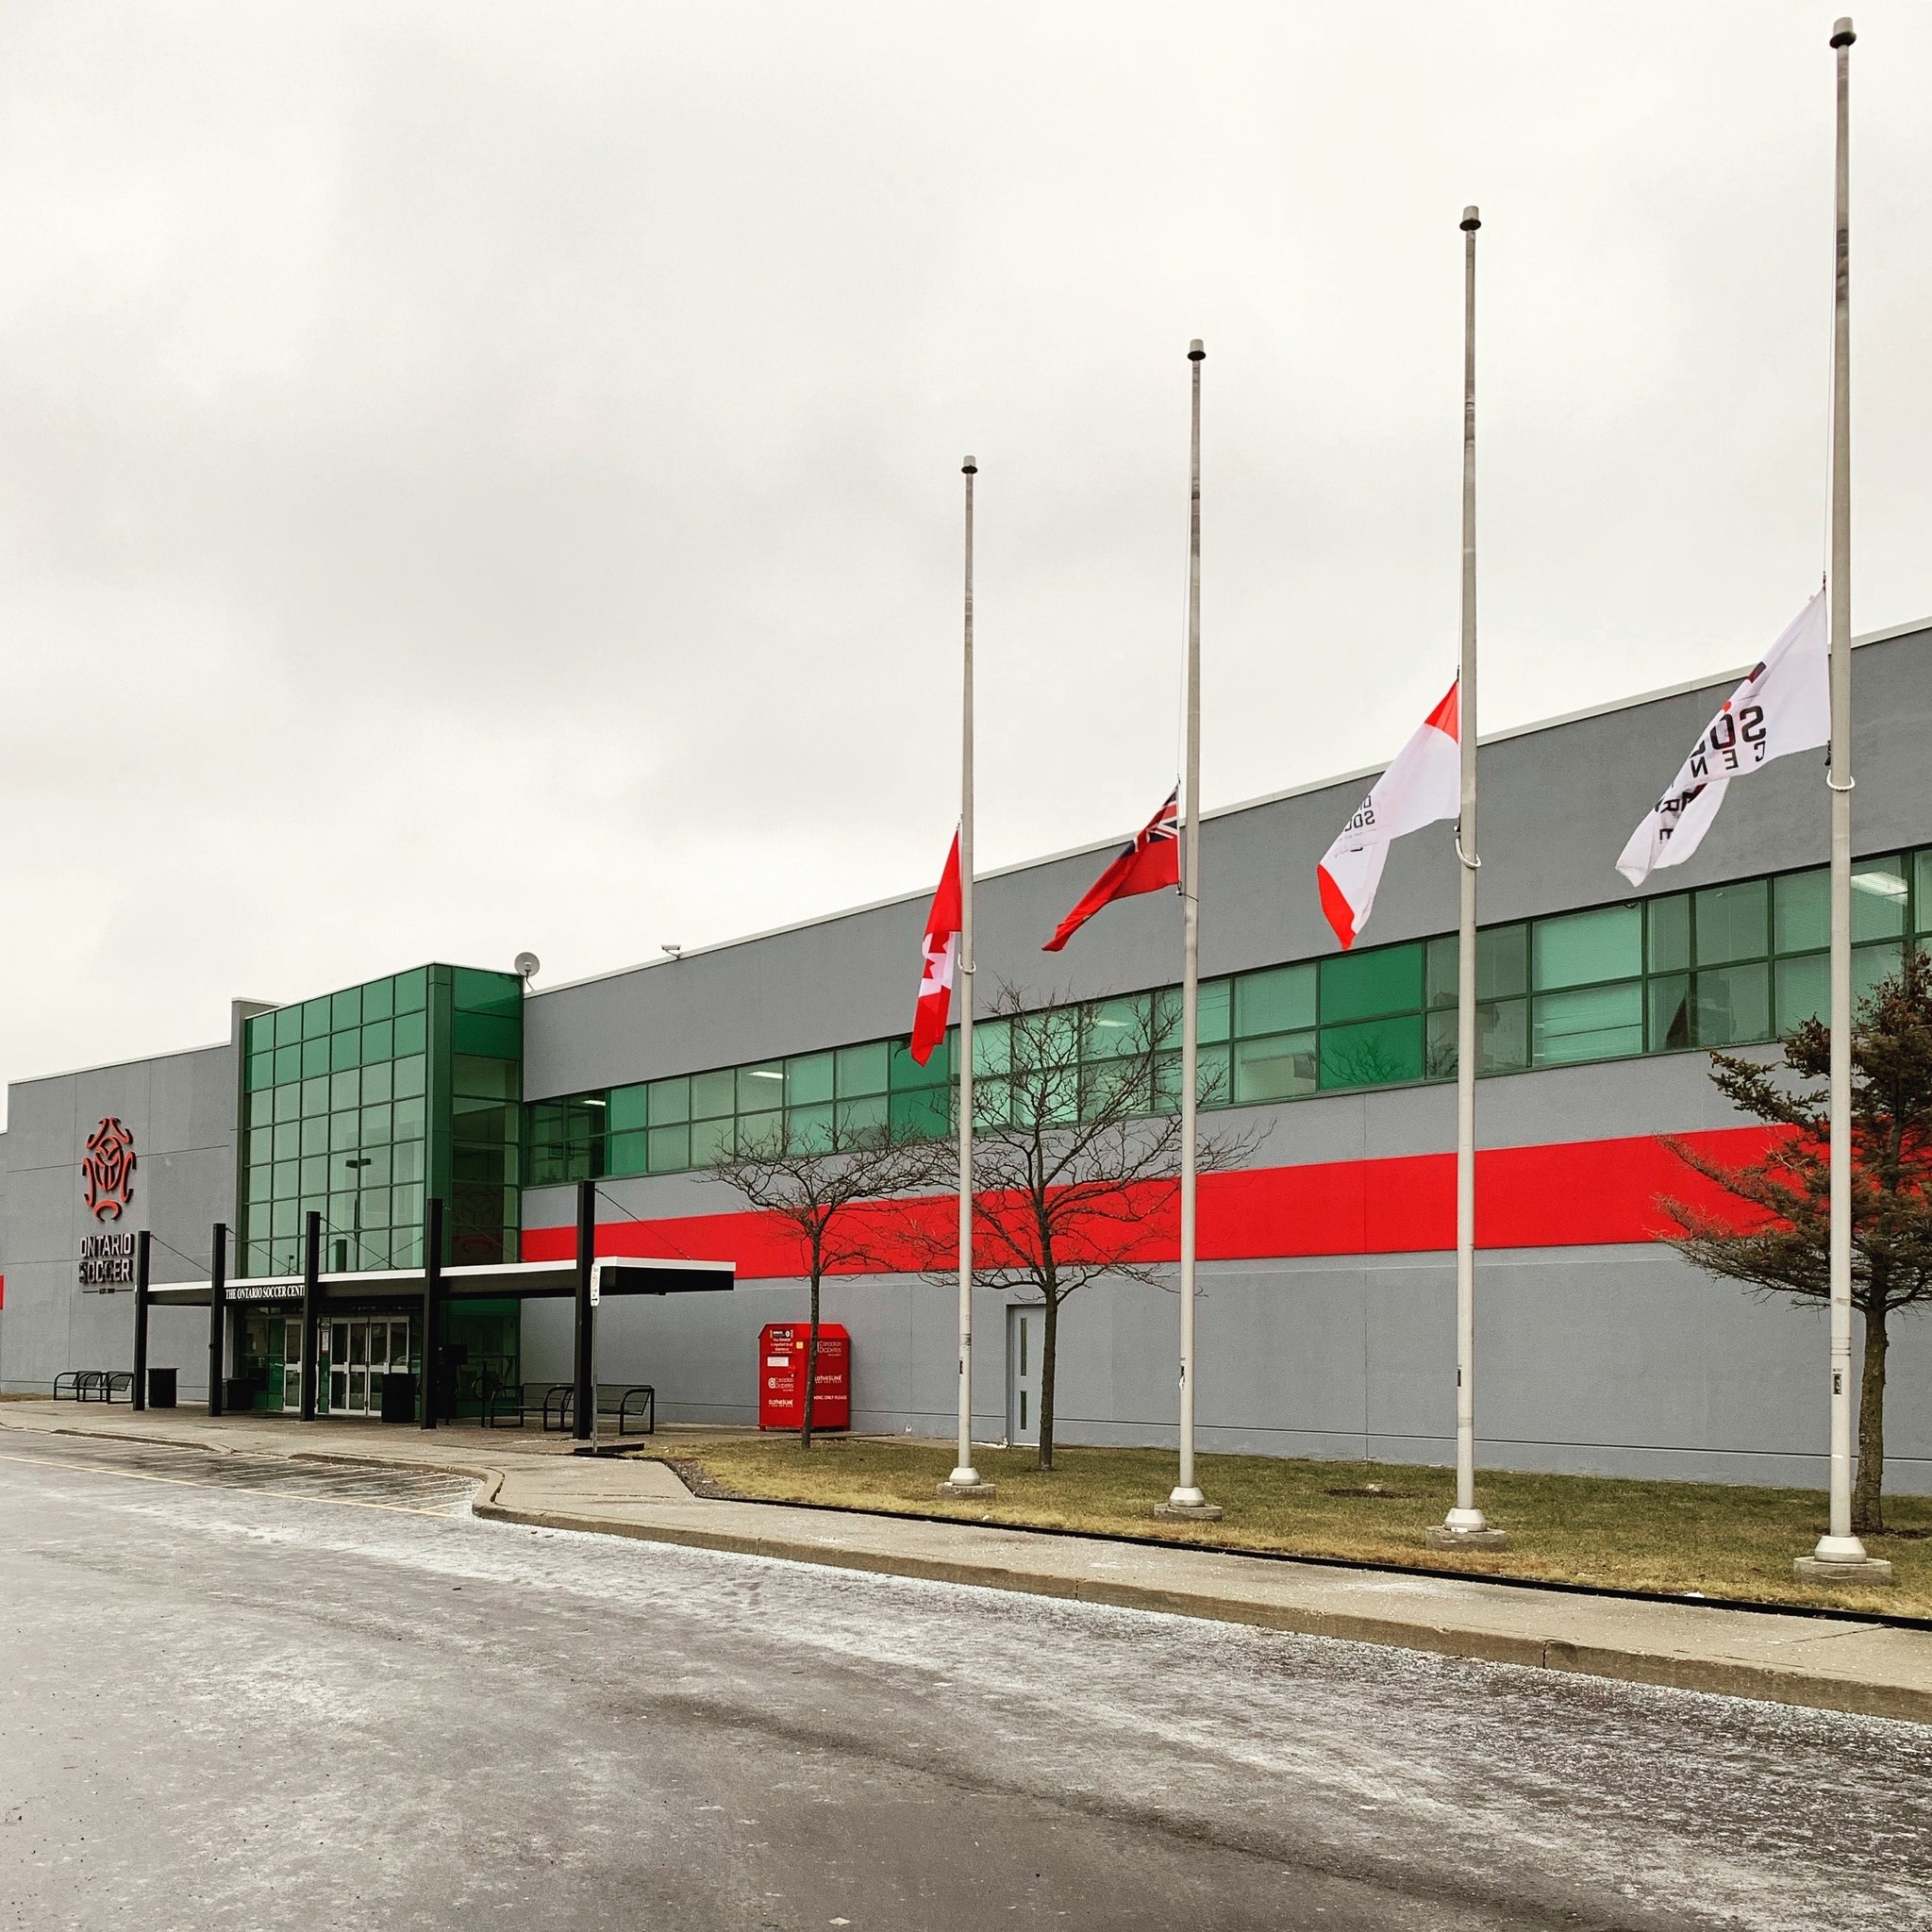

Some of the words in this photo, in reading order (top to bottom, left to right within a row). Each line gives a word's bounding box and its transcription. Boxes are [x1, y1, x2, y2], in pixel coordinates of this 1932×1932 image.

[79, 1233, 135, 1257] ONTARIO
[78, 1258, 134, 1284] SOCCER
[225, 1289, 237, 1300] THE
[237, 1288, 262, 1299] ONTARIO
[263, 1286, 287, 1298] SOCCER
[287, 1285, 305, 1297] CENT
